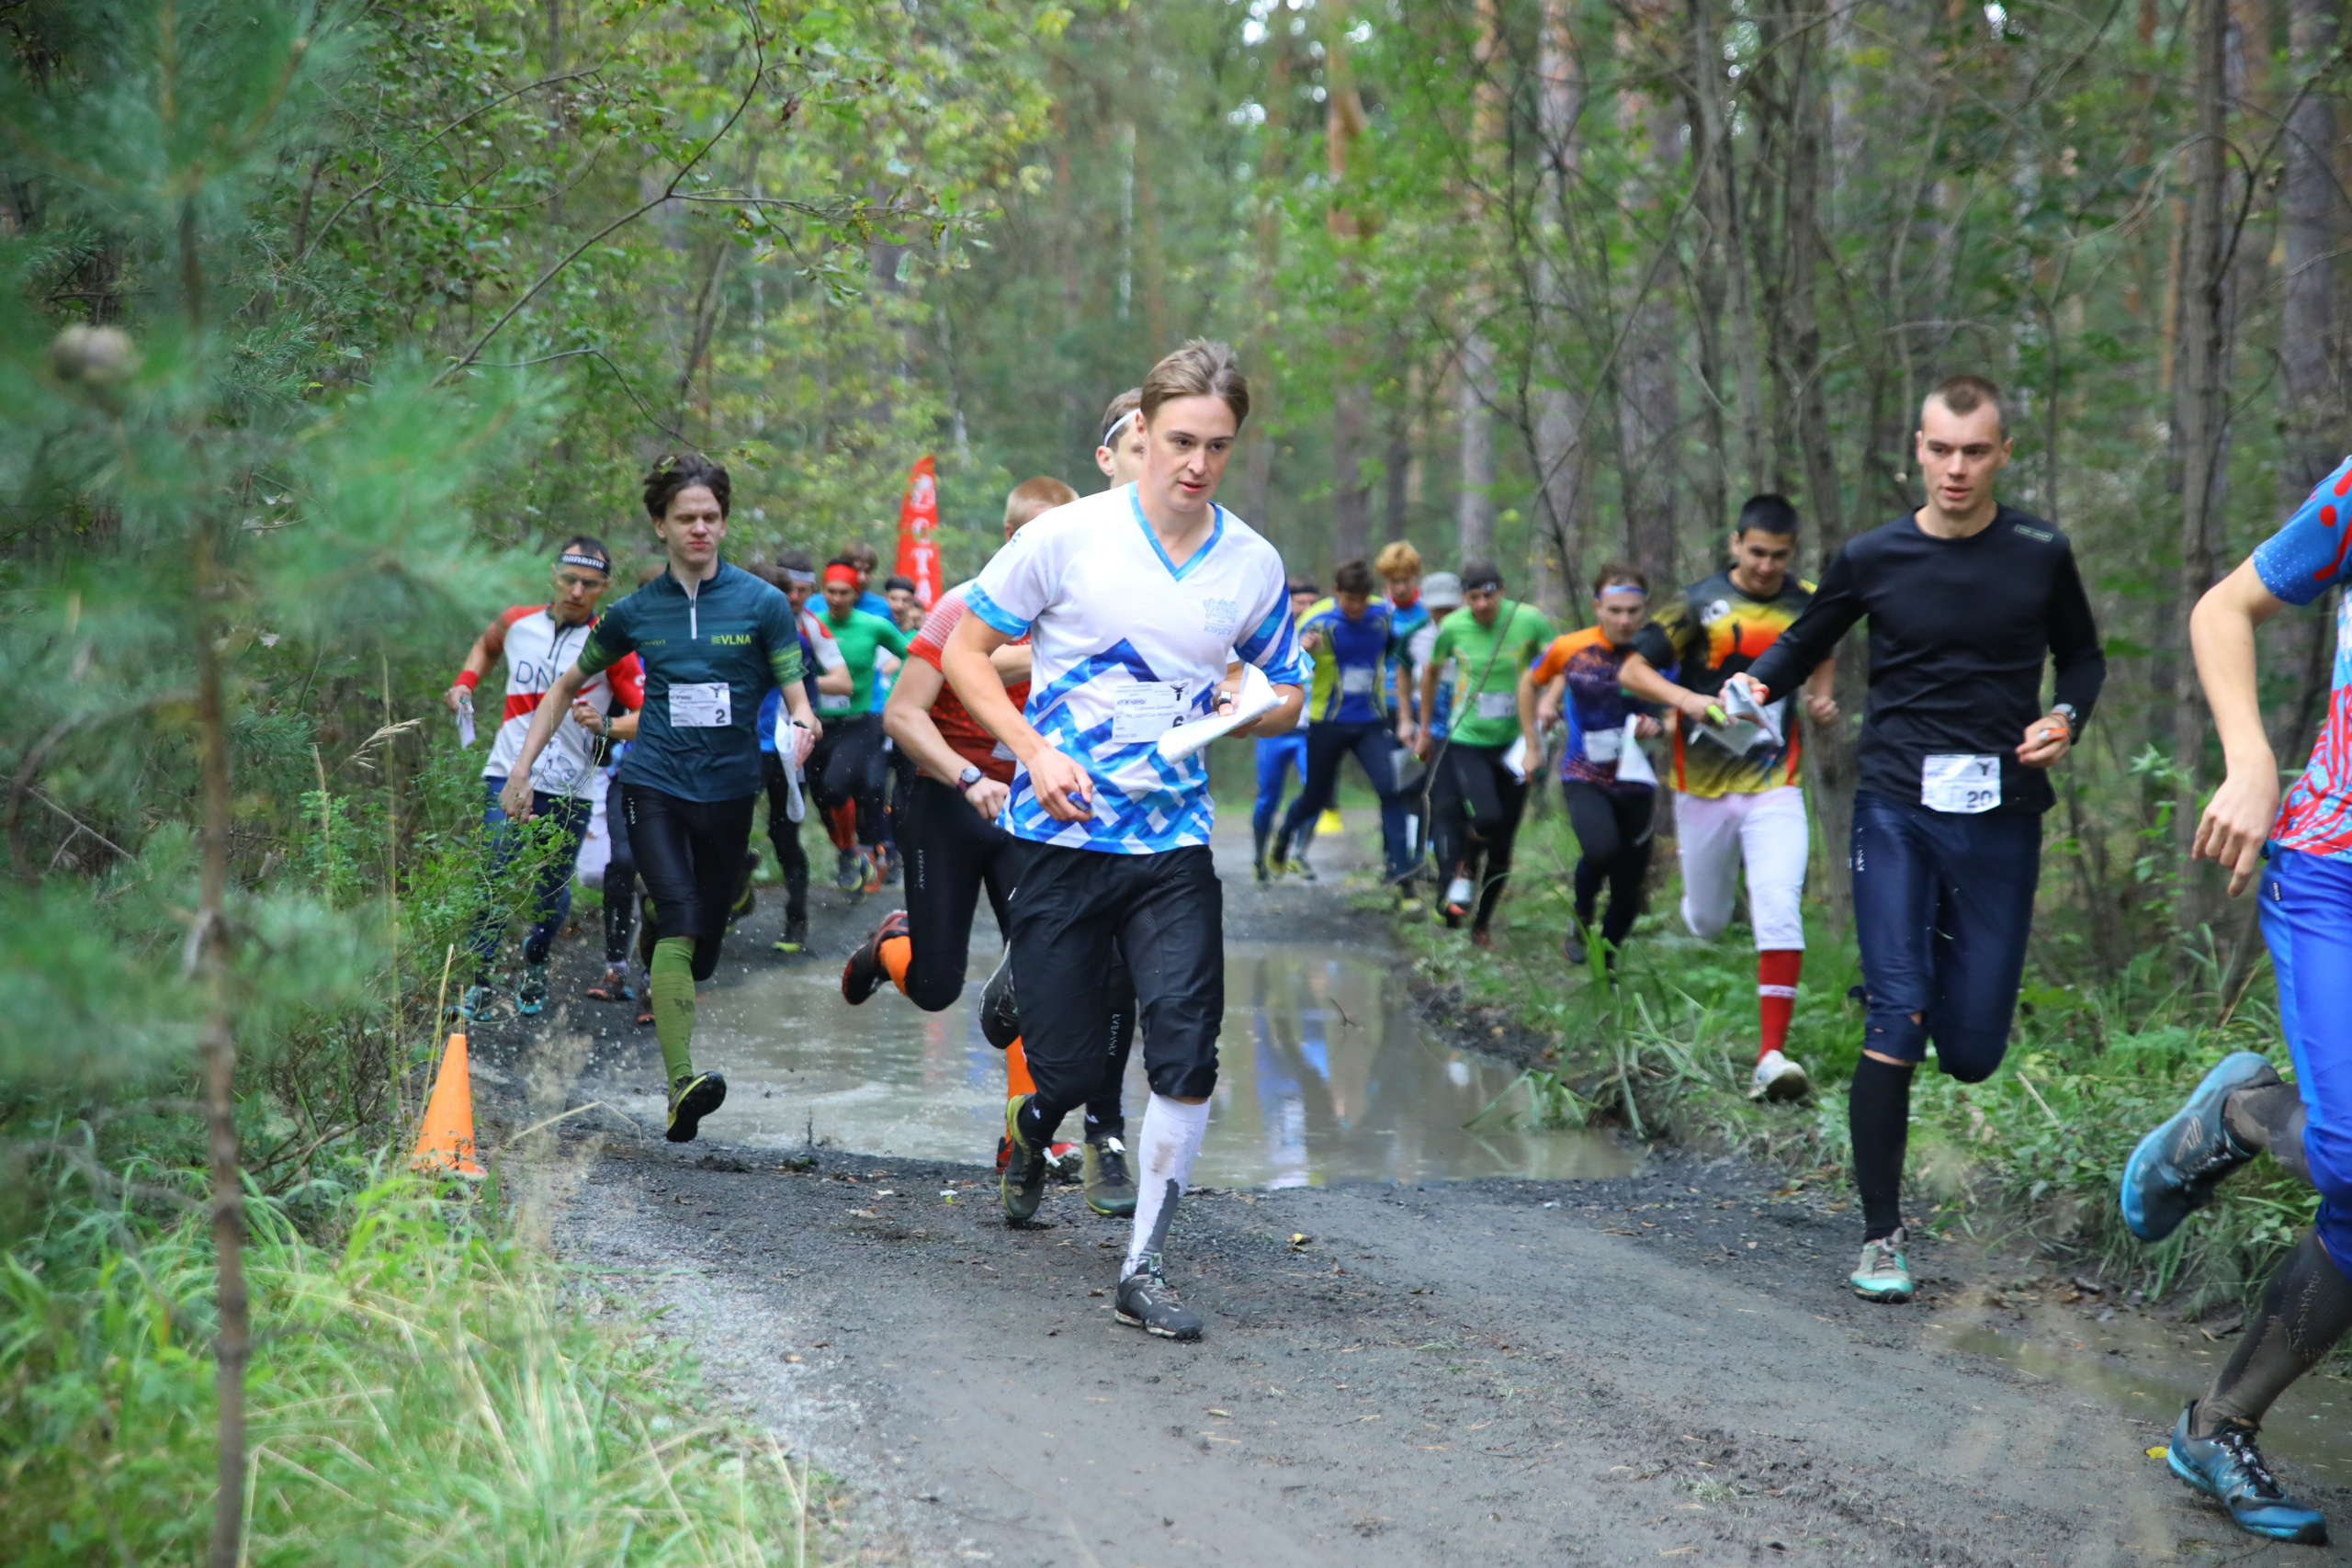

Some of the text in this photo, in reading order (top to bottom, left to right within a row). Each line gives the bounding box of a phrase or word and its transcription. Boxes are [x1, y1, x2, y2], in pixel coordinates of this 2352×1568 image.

[720, 634, 752, 645] VLNA
[715, 708, 727, 725] 2
[1966, 790, 1994, 808] 20
